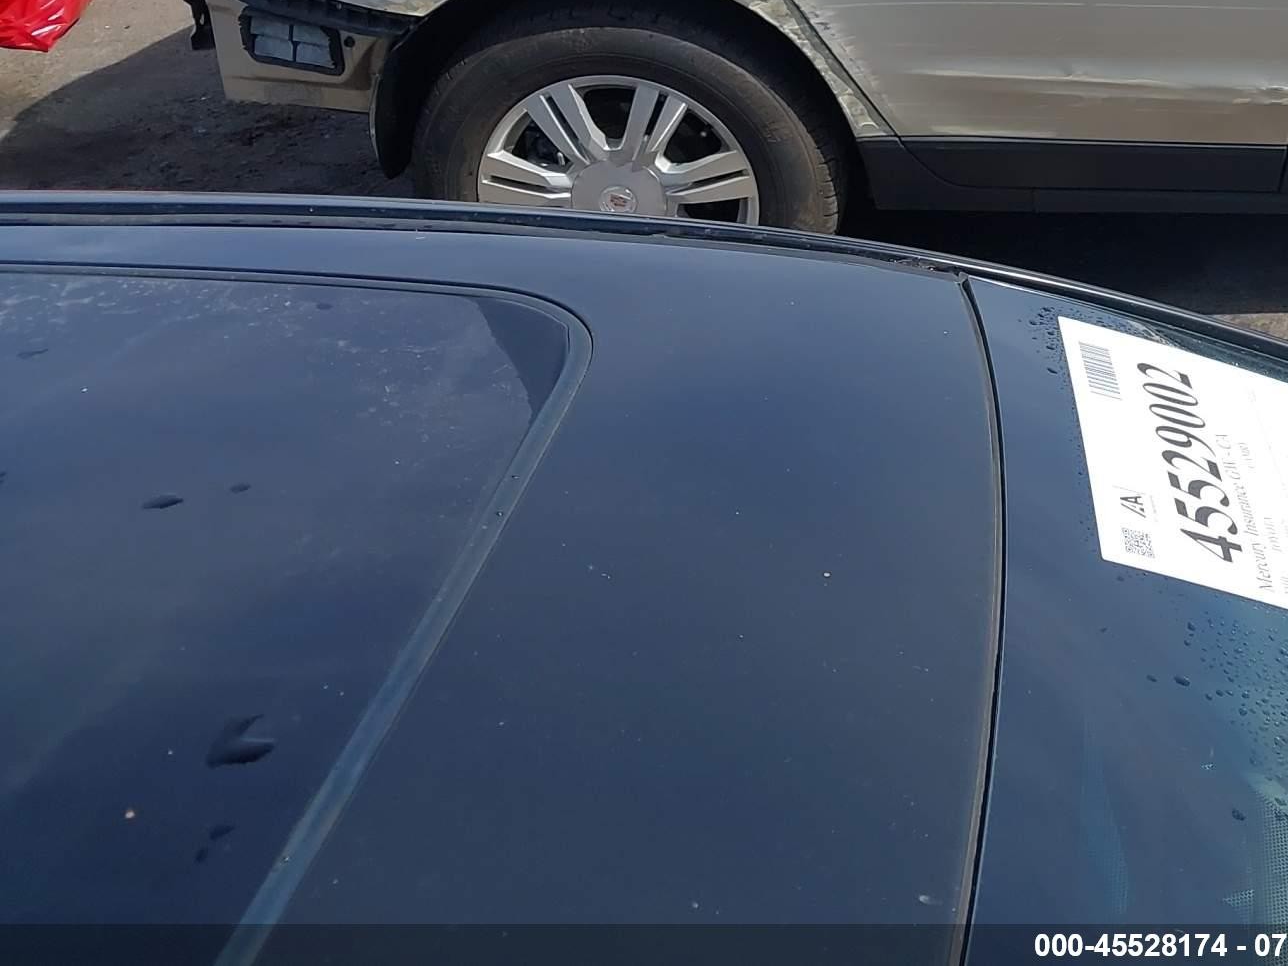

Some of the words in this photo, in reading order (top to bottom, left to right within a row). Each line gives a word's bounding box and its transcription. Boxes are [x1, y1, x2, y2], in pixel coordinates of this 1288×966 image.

[1136, 362, 1243, 563] 45529002
[1233, 482, 1260, 537] Insurance
[1251, 542, 1275, 593] Mercury
